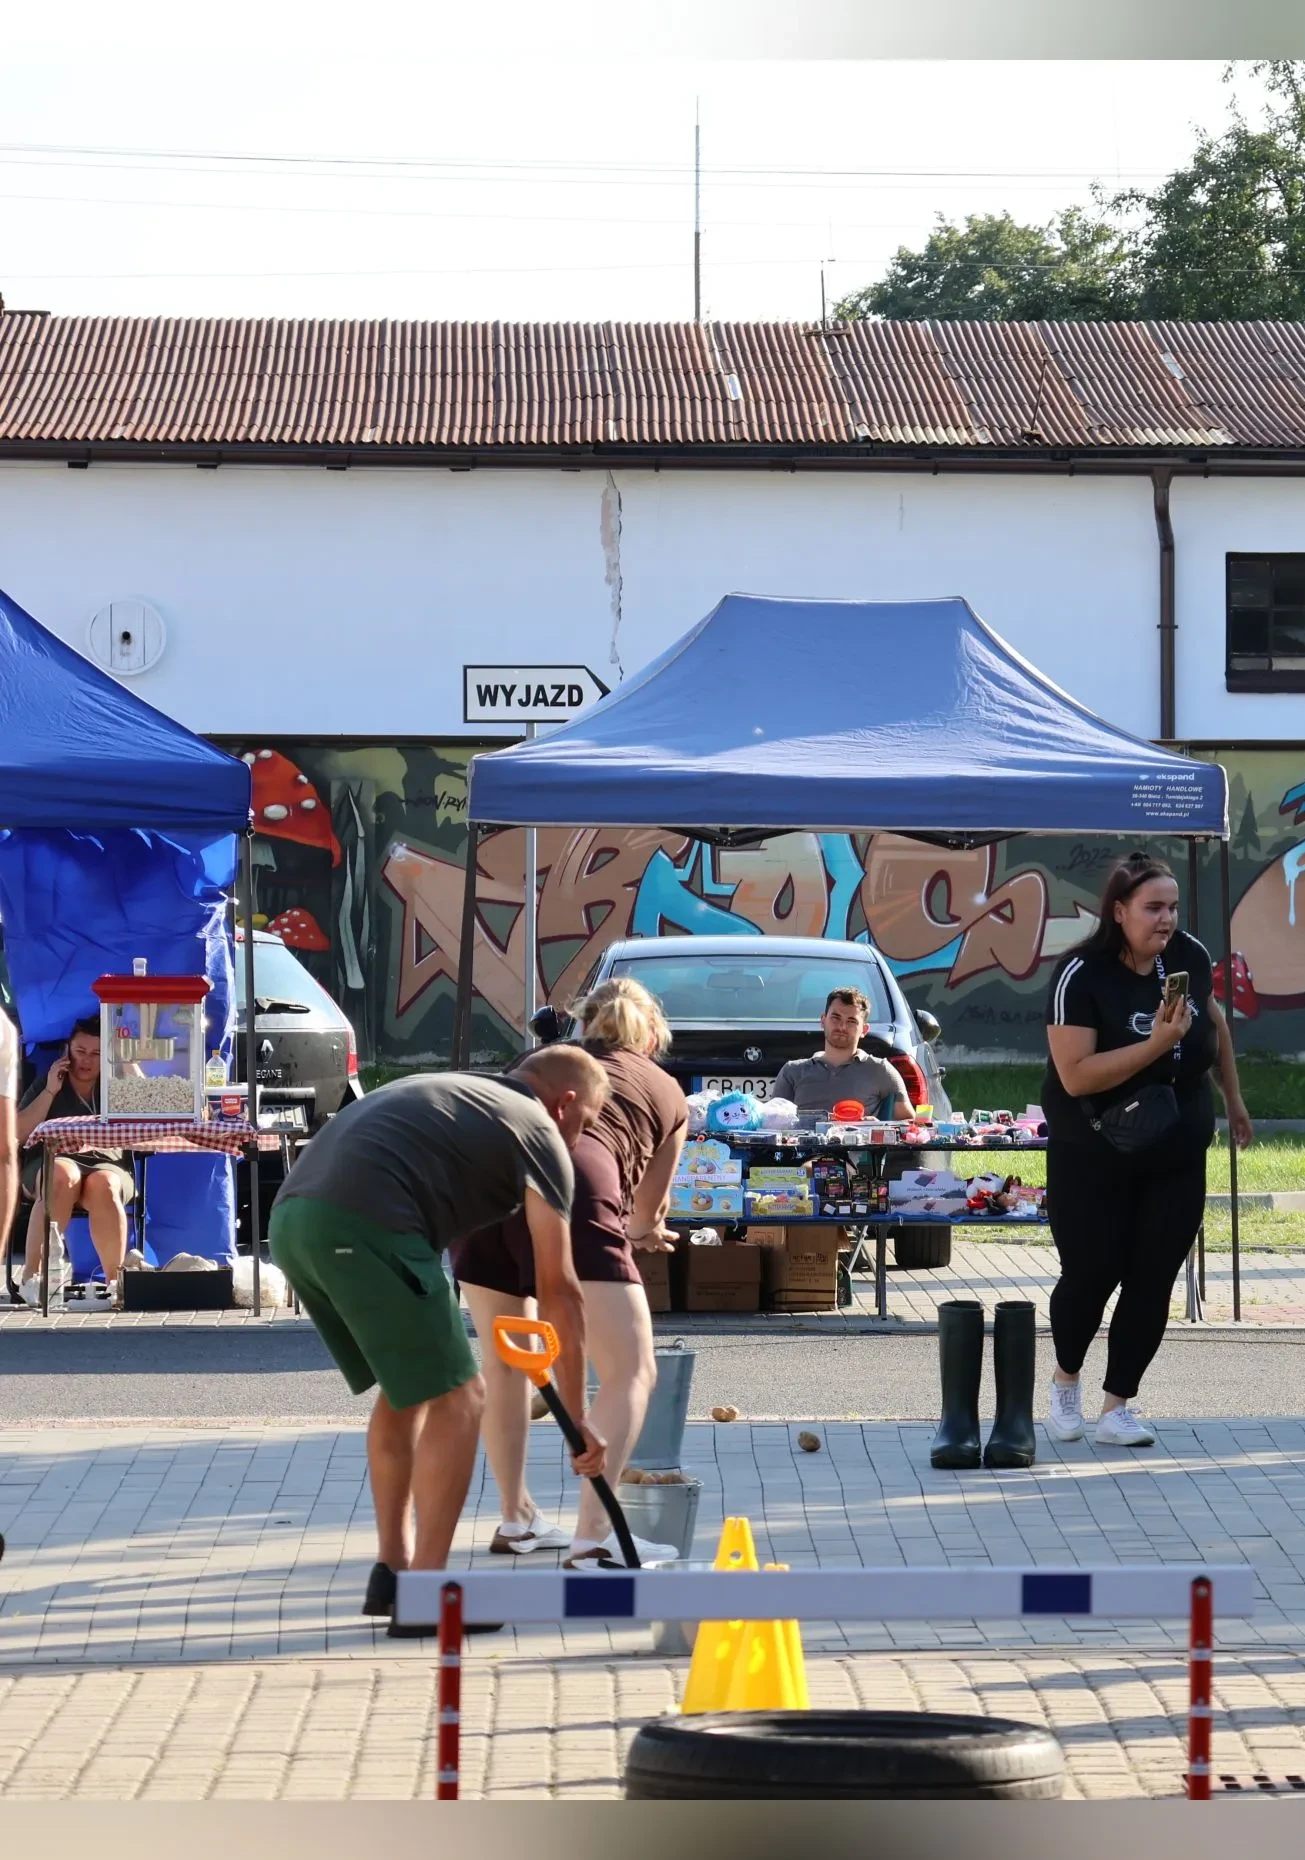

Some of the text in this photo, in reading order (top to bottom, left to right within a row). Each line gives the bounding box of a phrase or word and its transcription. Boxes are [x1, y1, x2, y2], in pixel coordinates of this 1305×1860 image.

[476, 684, 584, 707] WYJAZD
[1156, 772, 1195, 782] ekspand
[115, 1026, 130, 1038] 10
[256, 1069, 282, 1079] EGANE
